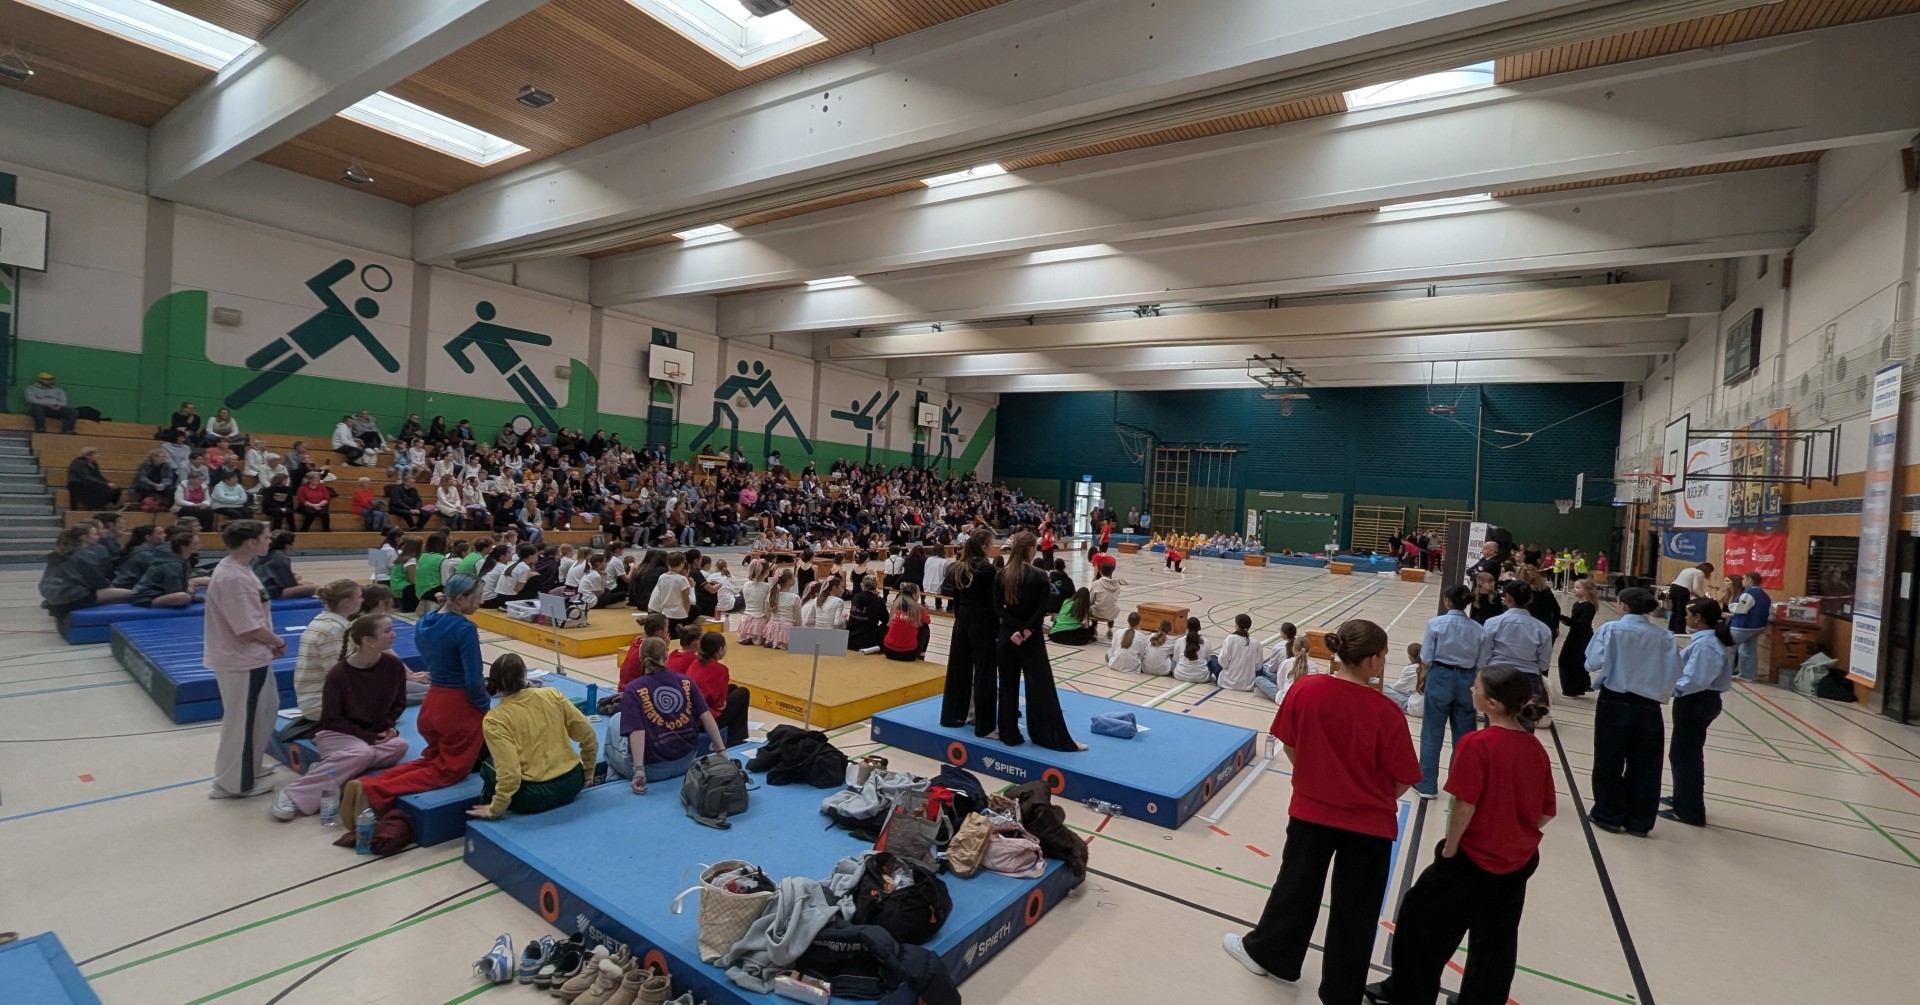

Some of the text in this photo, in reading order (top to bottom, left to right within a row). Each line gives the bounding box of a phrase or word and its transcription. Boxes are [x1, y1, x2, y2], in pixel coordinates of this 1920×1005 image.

[1468, 551, 1482, 560] POKA
[636, 687, 664, 725] Radiate
[779, 701, 804, 713] BENZ
[994, 761, 1027, 778] SPIETH
[588, 925, 622, 953] SPIET
[978, 921, 1011, 957] SPIETH
